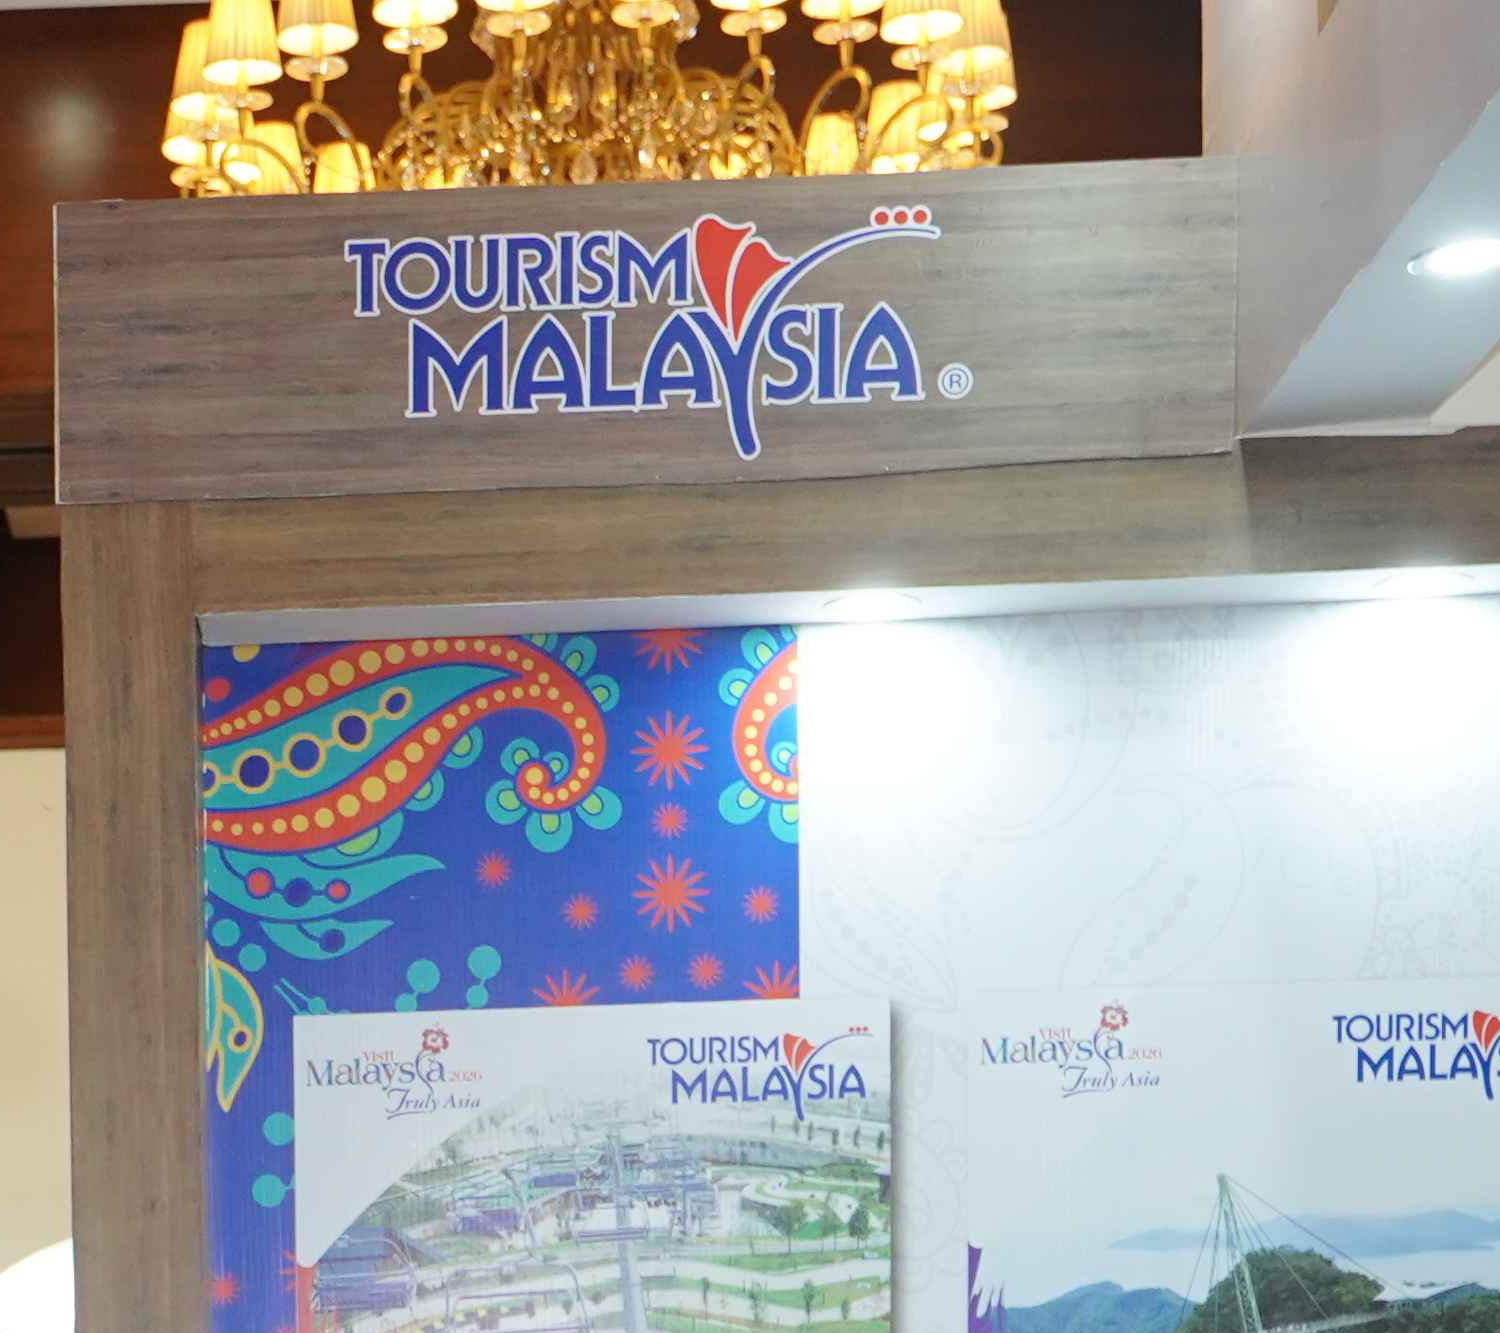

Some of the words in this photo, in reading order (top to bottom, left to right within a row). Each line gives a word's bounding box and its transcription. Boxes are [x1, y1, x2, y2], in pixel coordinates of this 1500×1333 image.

[345, 232, 692, 317] TOURISM
[405, 300, 926, 460] MALAYSIA
[1038, 1027, 1072, 1040] Visit
[1331, 1012, 1470, 1044] TOURISM
[362, 1050, 395, 1063] Visit
[646, 1036, 779, 1066] TOURISM
[1126, 1048, 1163, 1061] 2026
[448, 1070, 483, 1083] 2026
[1061, 1065, 1118, 1092] Truly
[1120, 1070, 1161, 1088] Asia
[386, 1088, 440, 1116] Truly
[444, 1093, 482, 1111] Asia
[669, 1063, 867, 1121] MALAYSIA
